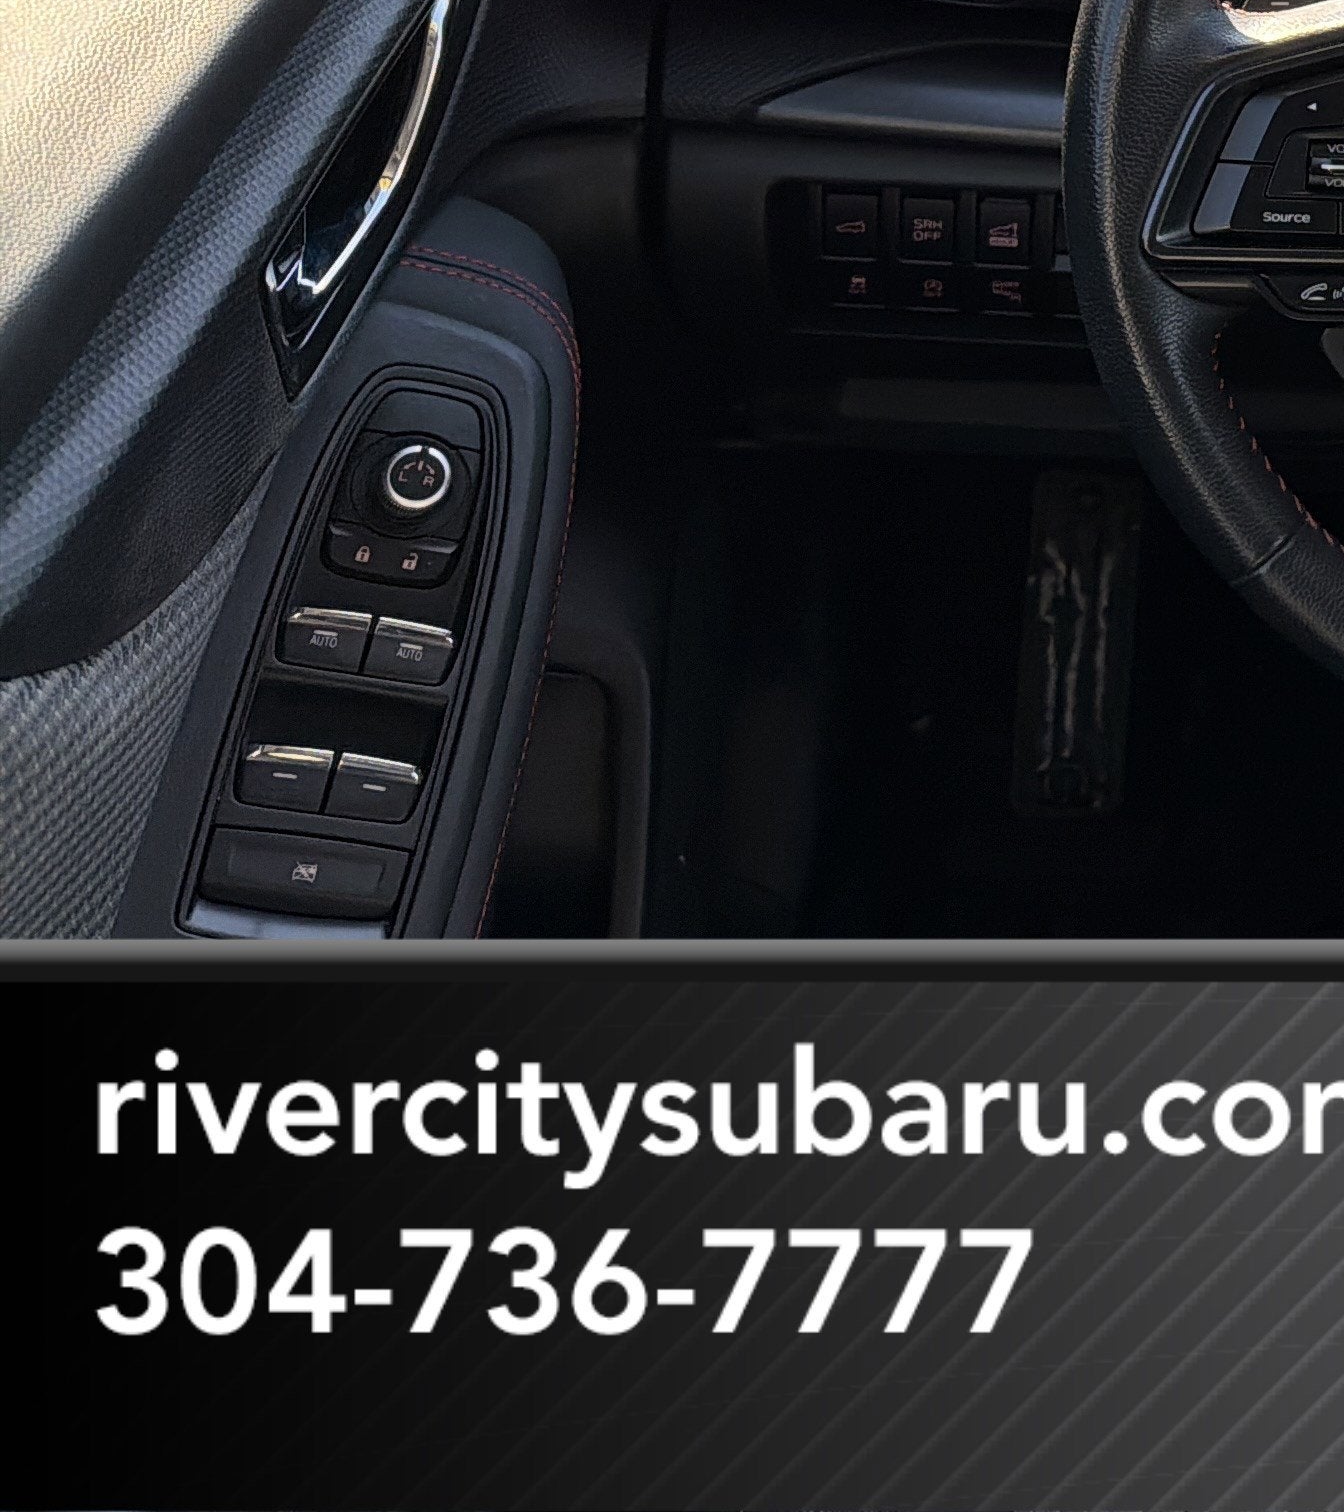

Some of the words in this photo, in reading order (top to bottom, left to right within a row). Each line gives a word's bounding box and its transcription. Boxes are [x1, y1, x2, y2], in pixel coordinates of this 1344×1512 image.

[399, 471, 407, 482] L
[423, 473, 435, 486] R
[309, 634, 338, 649] AUTO
[395, 647, 423, 662] AUTO
